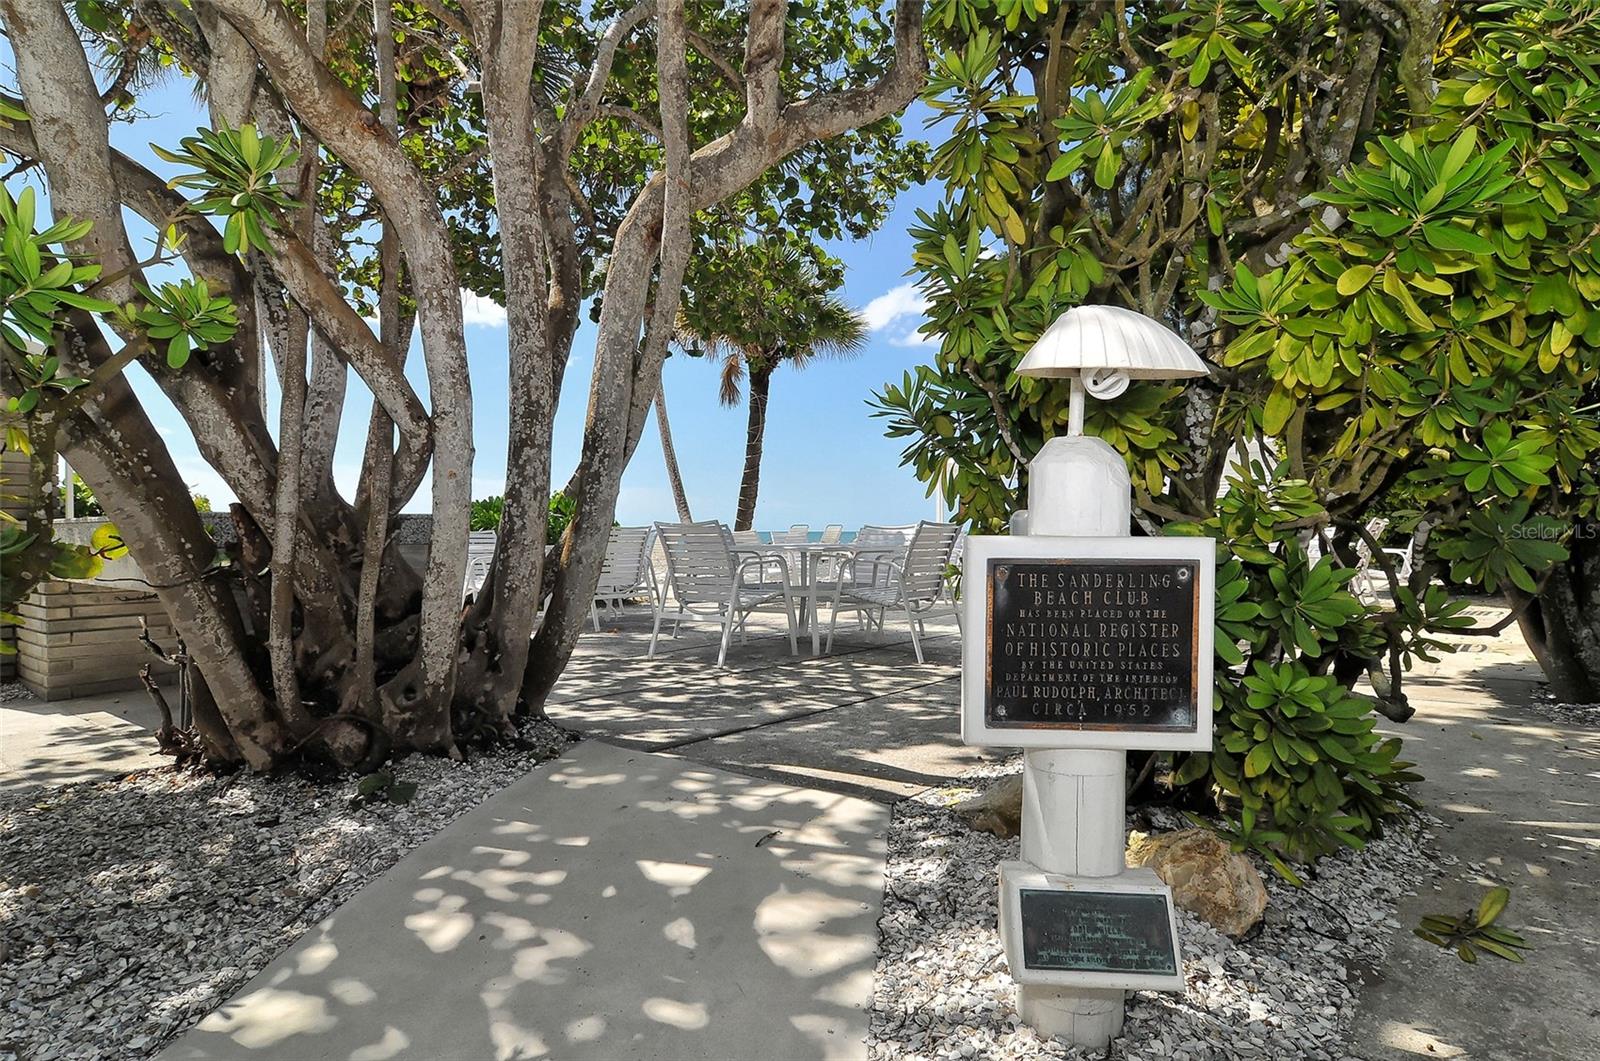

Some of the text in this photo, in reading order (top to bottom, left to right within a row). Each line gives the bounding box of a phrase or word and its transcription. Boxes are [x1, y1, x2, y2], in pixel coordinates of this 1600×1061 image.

[1017, 573, 1171, 589] THE SANDERLING
[1034, 591, 1149, 605] BEACH CLUB
[1019, 609, 1167, 619] HAS BEEN PLACED ON THE
[1006, 623, 1180, 638] NATIONAL REGISTER
[1005, 642, 1181, 658] OF HISTORIC PLACES
[1021, 661, 1164, 670] BY THE UNITED STATES
[1005, 673, 1178, 684] DEPARTMENT OF THE INTERIOR
[996, 686, 1028, 698] PAUL
[1033, 686, 1100, 701] RUDOLPH,
[1032, 703, 1150, 716] CIRCA 1952
